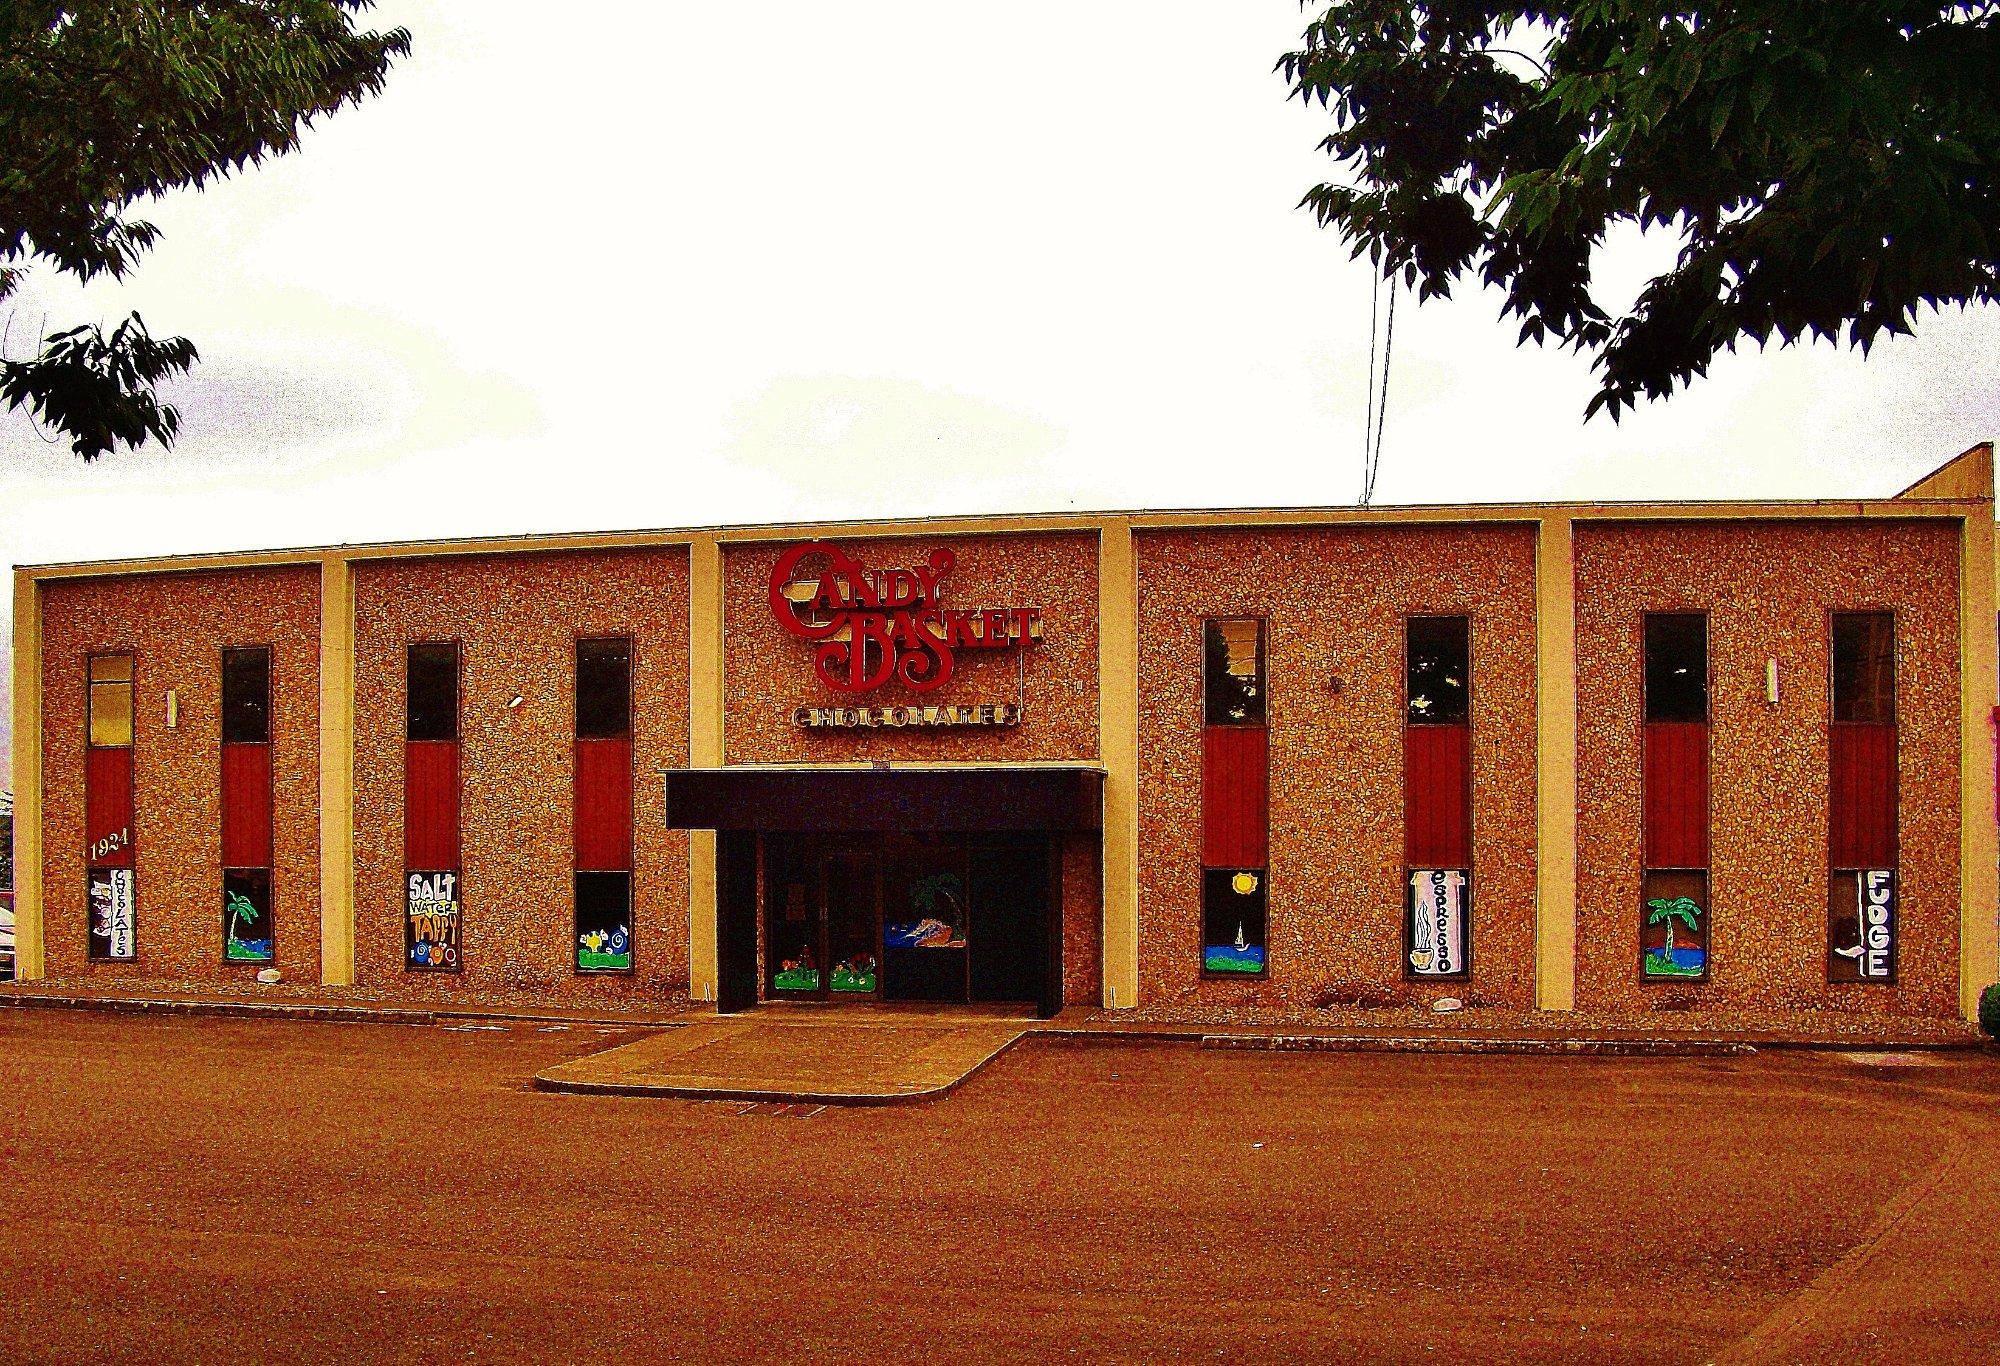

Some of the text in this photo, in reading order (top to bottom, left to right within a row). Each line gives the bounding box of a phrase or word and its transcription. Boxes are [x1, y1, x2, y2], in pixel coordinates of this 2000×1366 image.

[768, 542, 956, 638] CANDY
[814, 606, 1042, 693] BASKET
[792, 704, 1021, 728] CHOCOLATES
[410, 914, 457, 945] TAFFY
[1867, 870, 1891, 977] FUDGE
